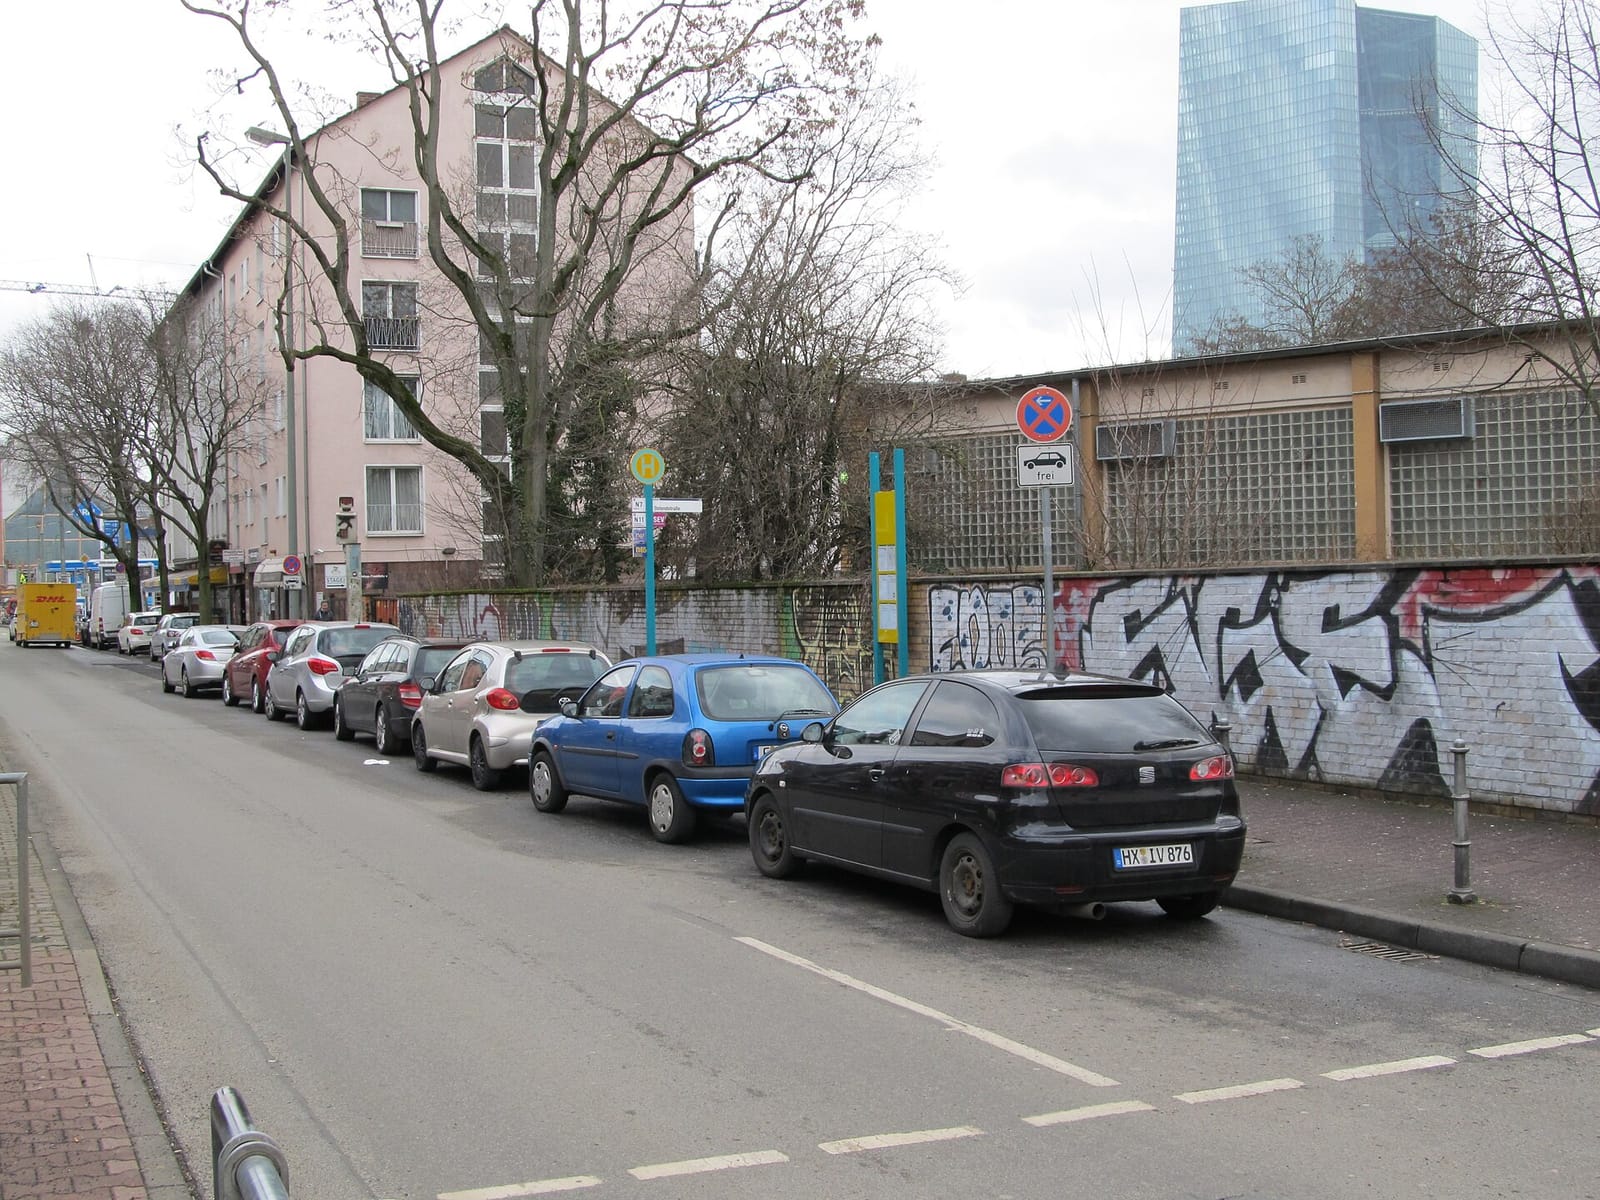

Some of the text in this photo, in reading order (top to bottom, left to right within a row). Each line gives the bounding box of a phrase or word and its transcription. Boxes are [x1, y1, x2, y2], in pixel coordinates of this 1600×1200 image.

[641, 455, 655, 477] H
[1037, 471, 1054, 480] frei
[1121, 846, 1191, 865] HX IV 876
